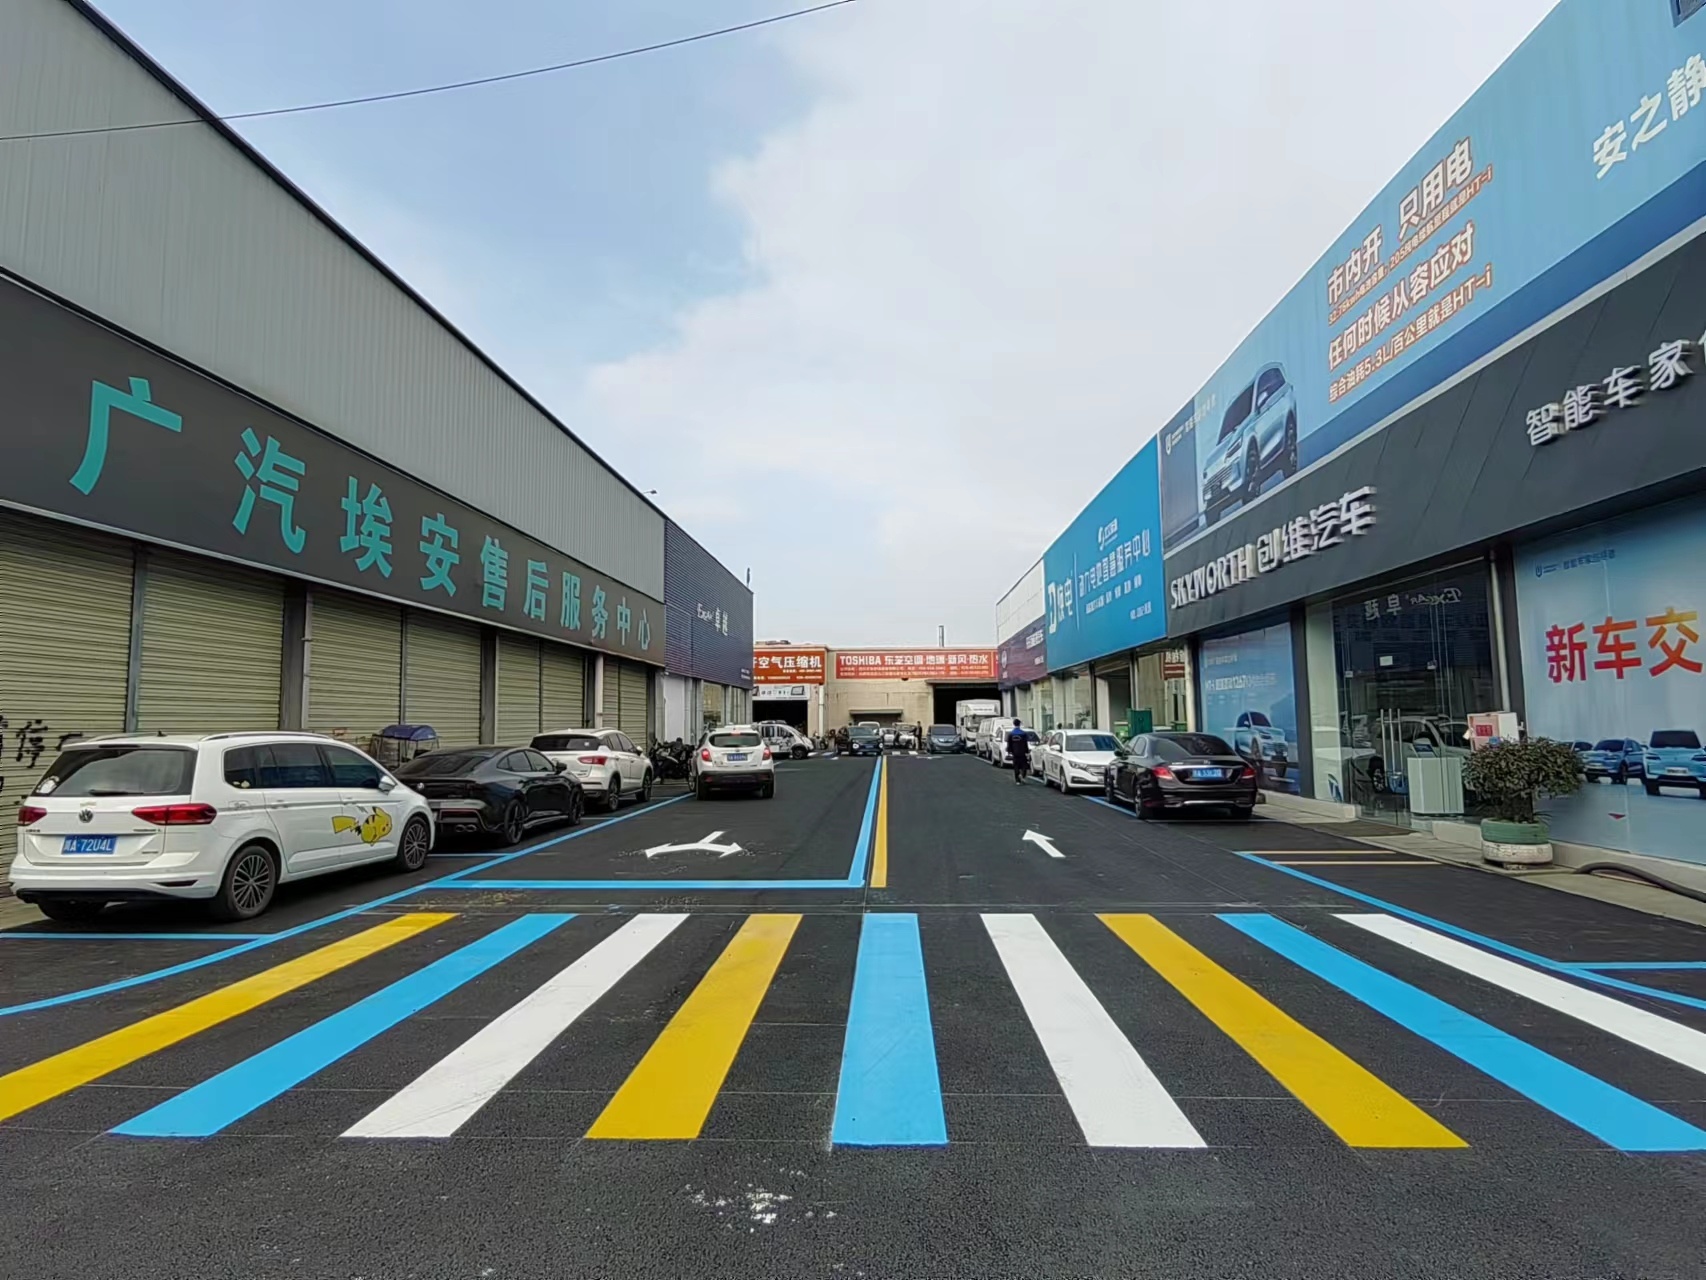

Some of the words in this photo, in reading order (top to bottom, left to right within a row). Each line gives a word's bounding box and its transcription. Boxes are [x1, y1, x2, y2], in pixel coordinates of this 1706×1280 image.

[1593, 53, 1706, 180] 安之静
[1328, 224, 1382, 304] 市内开
[1398, 137, 1472, 240] 只用电
[1328, 220, 1474, 371] 任何时候从容应对
[1526, 329, 1706, 446] 智能车家
[69, 377, 652, 651] 广汽埃安售后服务中心
[1171, 543, 1258, 609] SKYWORTH
[1257, 486, 1376, 574] 创维汽车
[840, 655, 881, 666] TOSHIBA
[1545, 607, 1703, 684] 新车交
